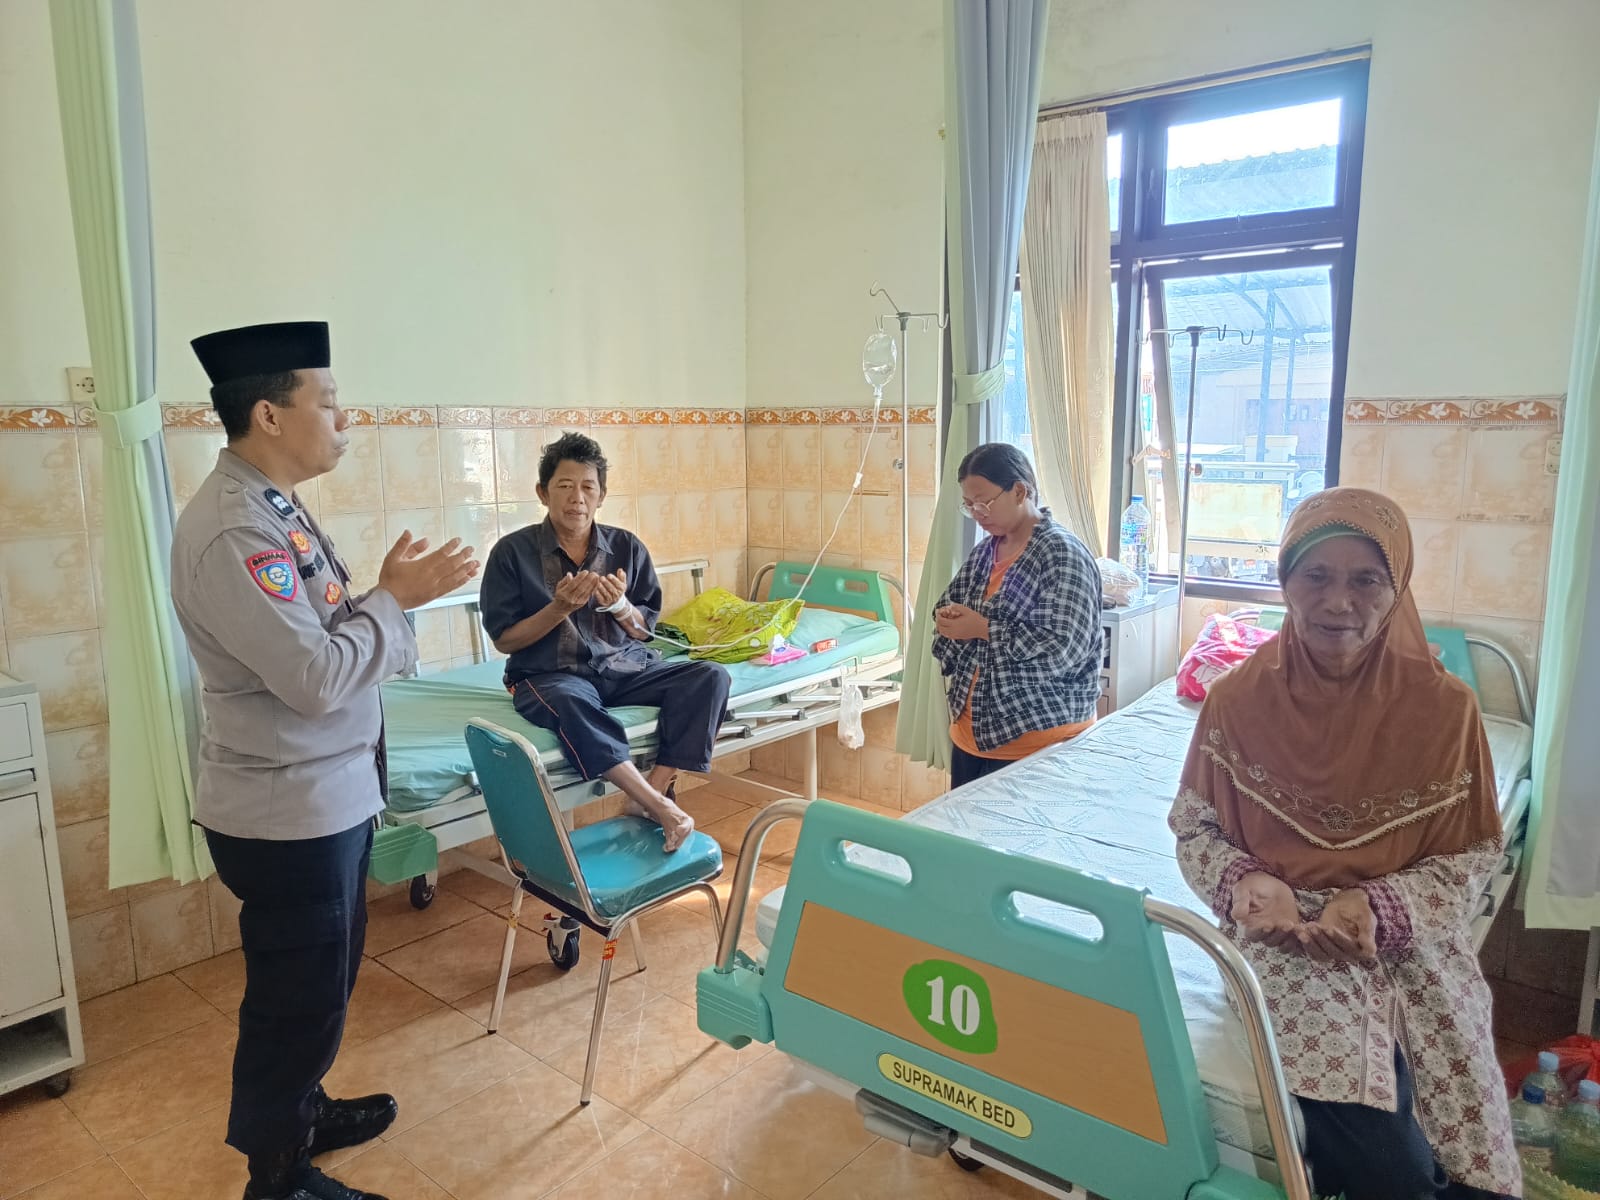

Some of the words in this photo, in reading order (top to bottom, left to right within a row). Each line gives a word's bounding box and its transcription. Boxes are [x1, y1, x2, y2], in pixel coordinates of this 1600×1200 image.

[926, 976, 980, 1036] 10
[893, 1061, 977, 1113] SUPRAMAK
[982, 1100, 1015, 1128] BED
